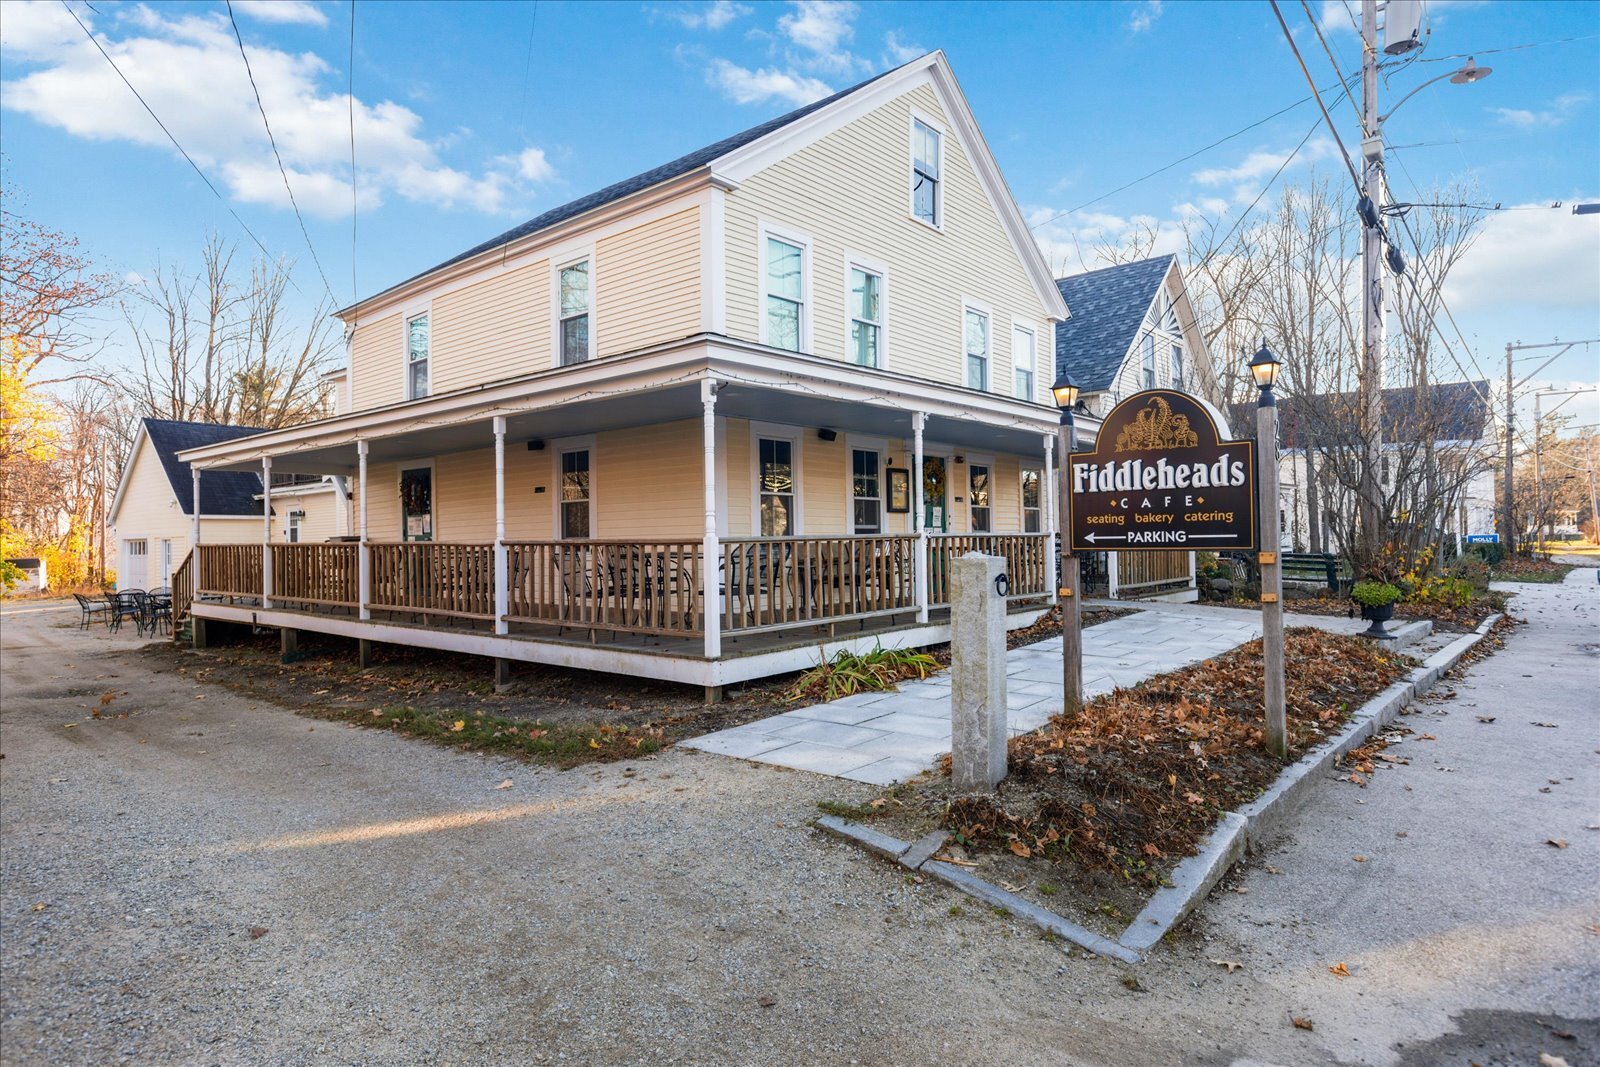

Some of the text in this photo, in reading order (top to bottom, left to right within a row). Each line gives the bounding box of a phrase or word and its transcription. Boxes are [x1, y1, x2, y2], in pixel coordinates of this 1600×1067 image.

[1073, 453, 1245, 493] Fiddleheads
[1120, 495, 1193, 509] CAFE
[1087, 510, 1234, 526] seating bakery catering
[1127, 530, 1187, 543] PARKING
